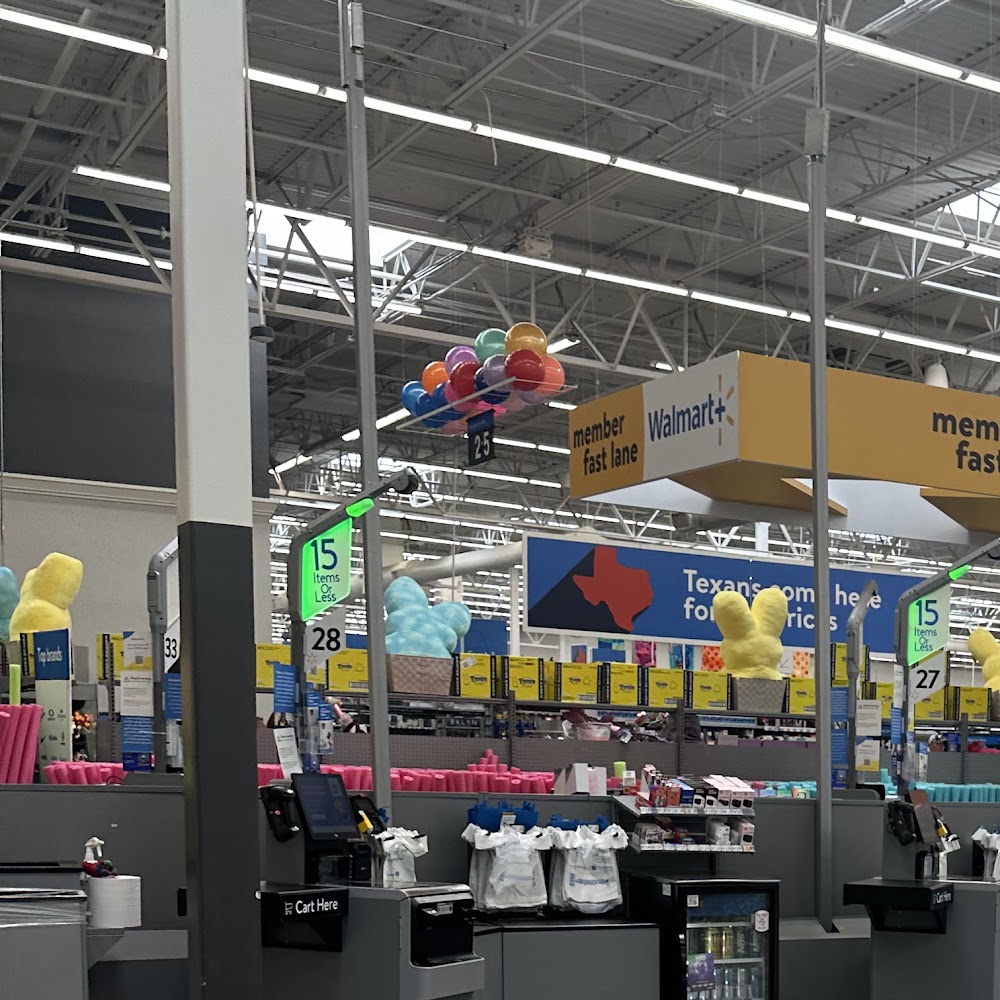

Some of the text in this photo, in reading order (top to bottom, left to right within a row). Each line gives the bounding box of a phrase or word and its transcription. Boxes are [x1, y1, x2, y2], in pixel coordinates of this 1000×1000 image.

[573, 411, 625, 449] member
[583, 440, 639, 476] fast lane
[310, 538, 338, 571] 15
[313, 572, 341, 584] Items
[315, 591, 337, 603] Less
[320, 584, 333, 595] Or
[835, 583, 882, 609] hee
[915, 600, 939, 626] 15
[311, 627, 341, 651] 28
[914, 626, 938, 637] Items
[919, 636, 929, 645] Or
[164, 637, 178, 659] 33
[914, 642, 934, 652] Less
[916, 669, 940, 689] 27
[295, 897, 339, 915] Cart Here
